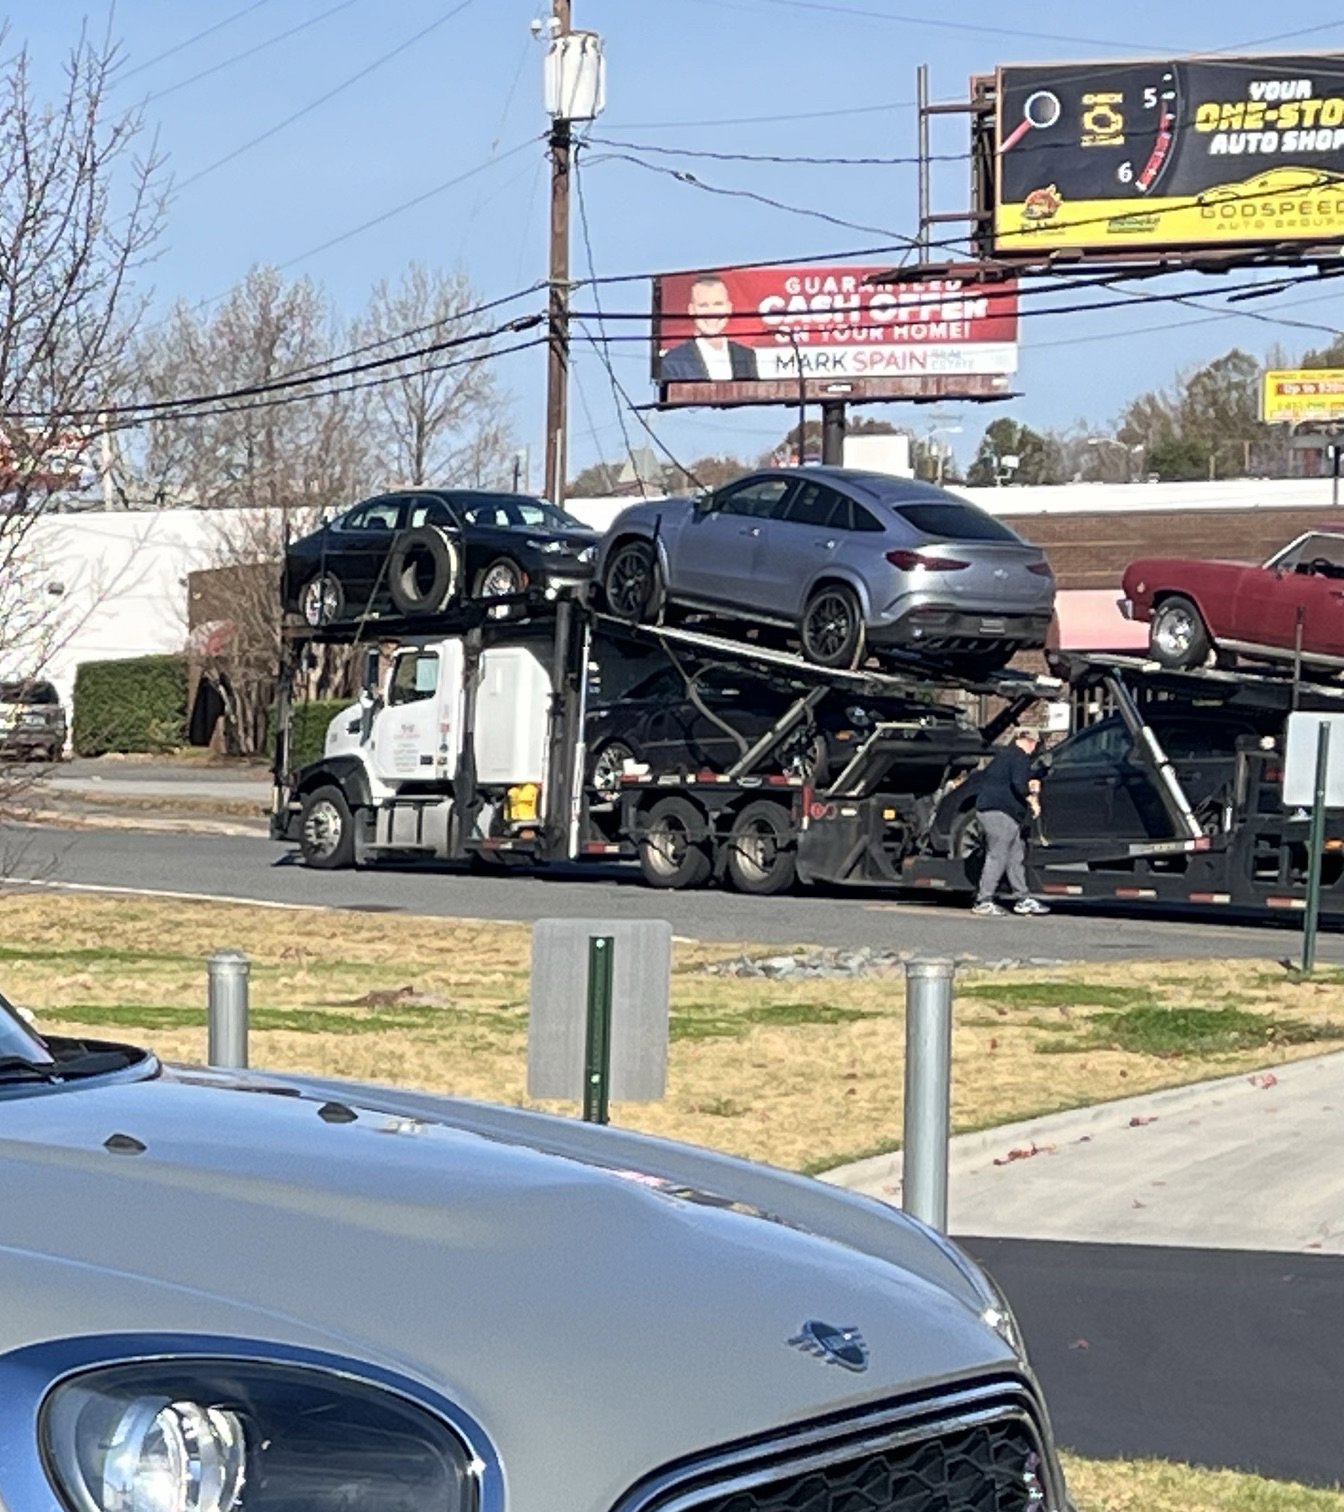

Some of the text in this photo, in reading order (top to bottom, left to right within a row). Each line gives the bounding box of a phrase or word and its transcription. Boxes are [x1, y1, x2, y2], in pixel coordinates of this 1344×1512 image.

[1143, 88, 1158, 109] 5
[1250, 79, 1312, 101] YOUR
[1195, 98, 1344, 132] ONE-STO
[1208, 131, 1279, 155] AUTO
[1118, 161, 1133, 182] 6
[1216, 219, 1265, 230] AUTO
[758, 291, 989, 325] CASH OFFER
[774, 321, 971, 343] ON YOUR HOME!
[776, 351, 928, 373] MARK SPAIN
